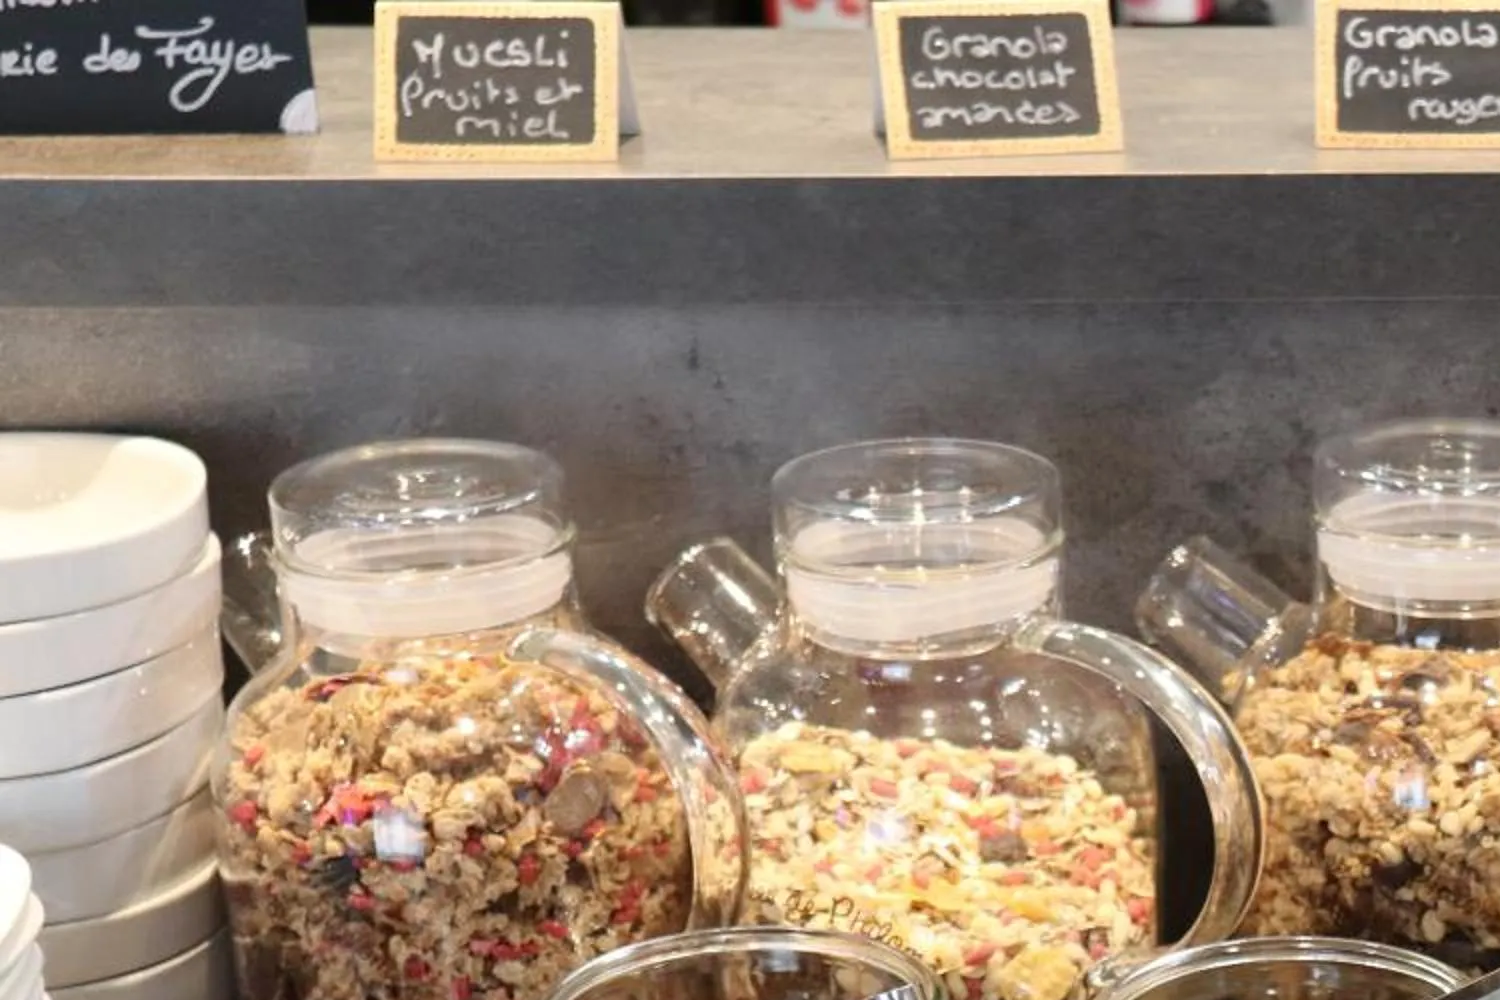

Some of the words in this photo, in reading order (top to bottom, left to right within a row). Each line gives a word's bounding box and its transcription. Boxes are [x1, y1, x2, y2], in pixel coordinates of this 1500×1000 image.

[922, 25, 1068, 60] Granola
[1343, 17, 1499, 49] Granola
[911, 61, 1076, 90] chocolat
[455, 110, 570, 138] miel
